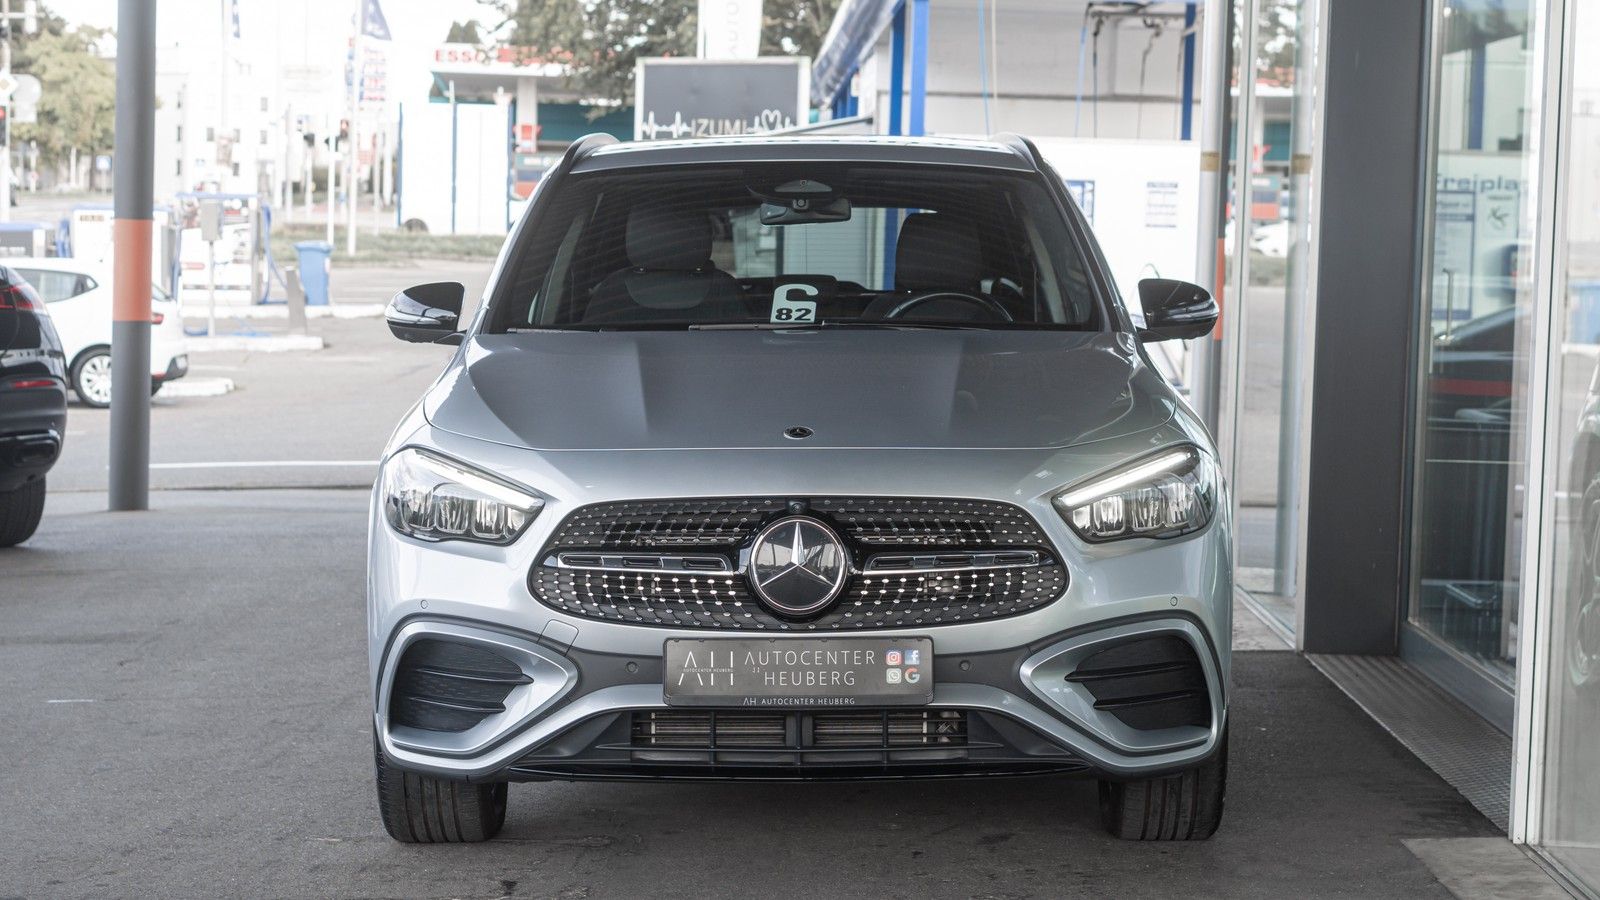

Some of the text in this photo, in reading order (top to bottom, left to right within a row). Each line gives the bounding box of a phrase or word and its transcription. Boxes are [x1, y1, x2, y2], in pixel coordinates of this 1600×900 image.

[691, 118, 748, 137] IZUMI
[775, 308, 812, 321] 82
[744, 650, 875, 666] AUTOCENTER
[678, 650, 734, 686] AH
[764, 671, 856, 686] HEUBERG
[743, 697, 855, 706] AH AUTOCENTER HEUBERG
